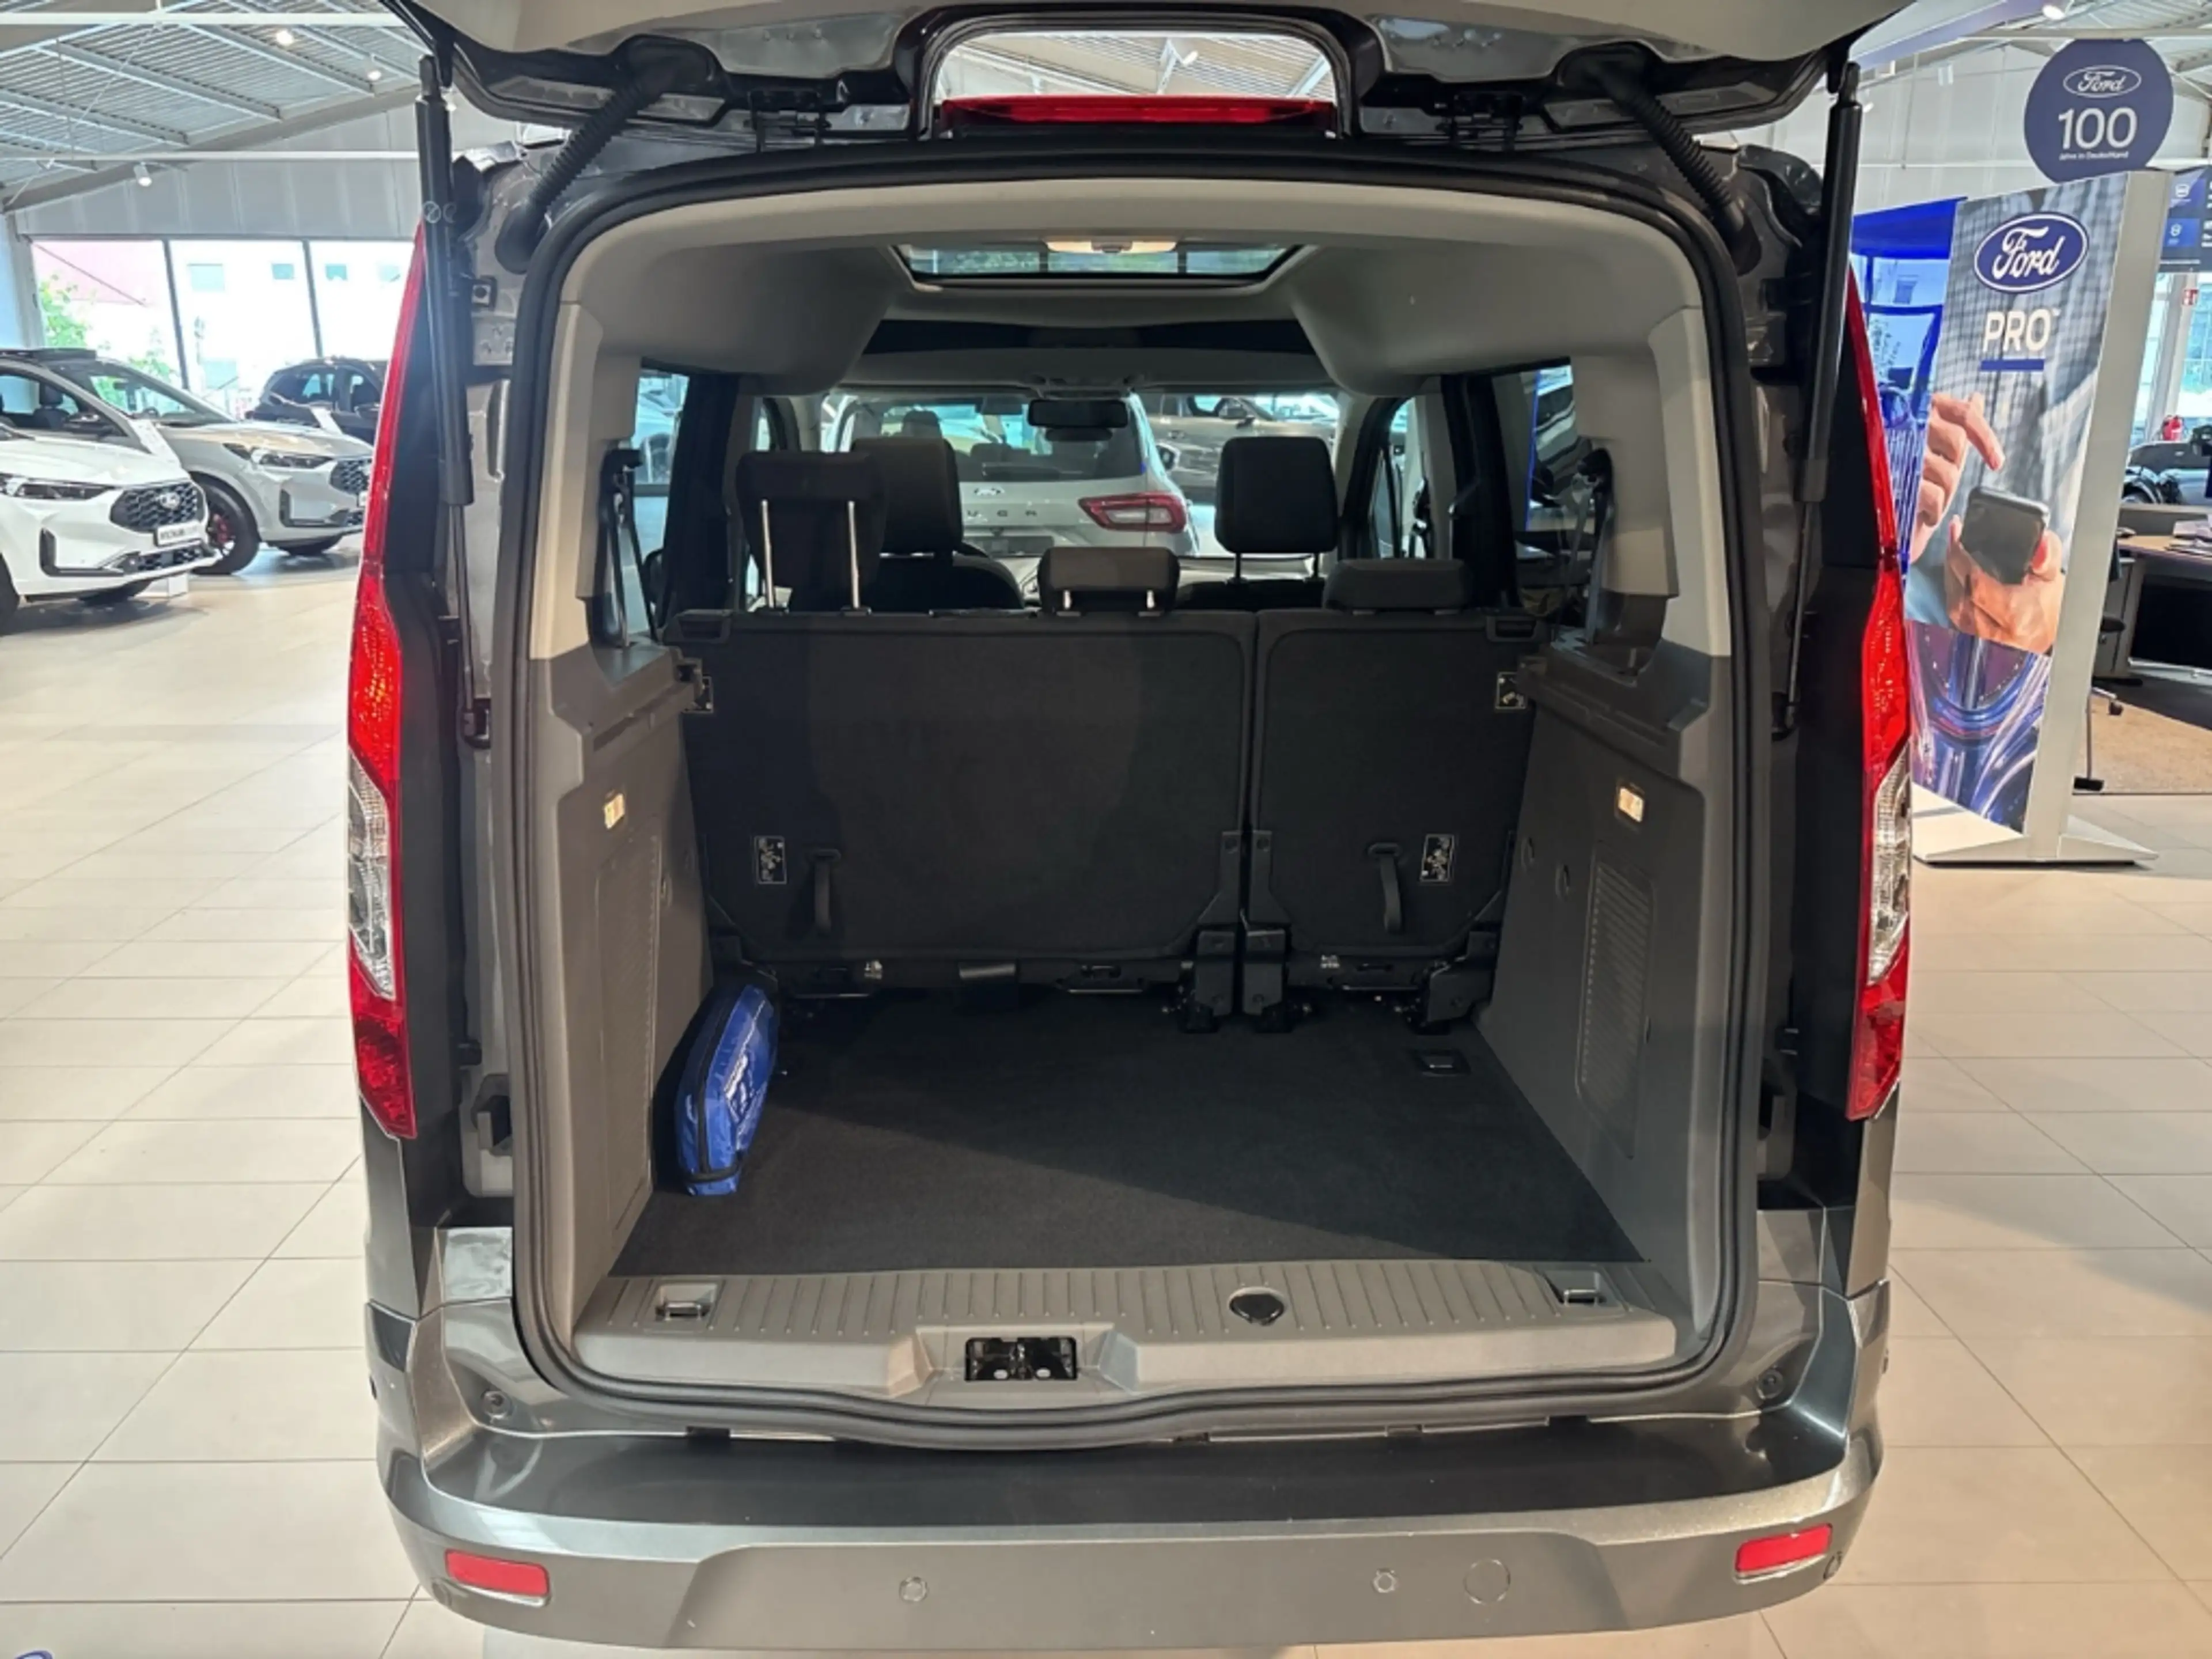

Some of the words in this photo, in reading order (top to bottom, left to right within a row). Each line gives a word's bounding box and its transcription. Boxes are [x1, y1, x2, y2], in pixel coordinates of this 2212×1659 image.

[2077, 70, 2127, 92] Ford
[2058, 107, 2138, 150] 100
[1991, 226, 2066, 280] Ford
